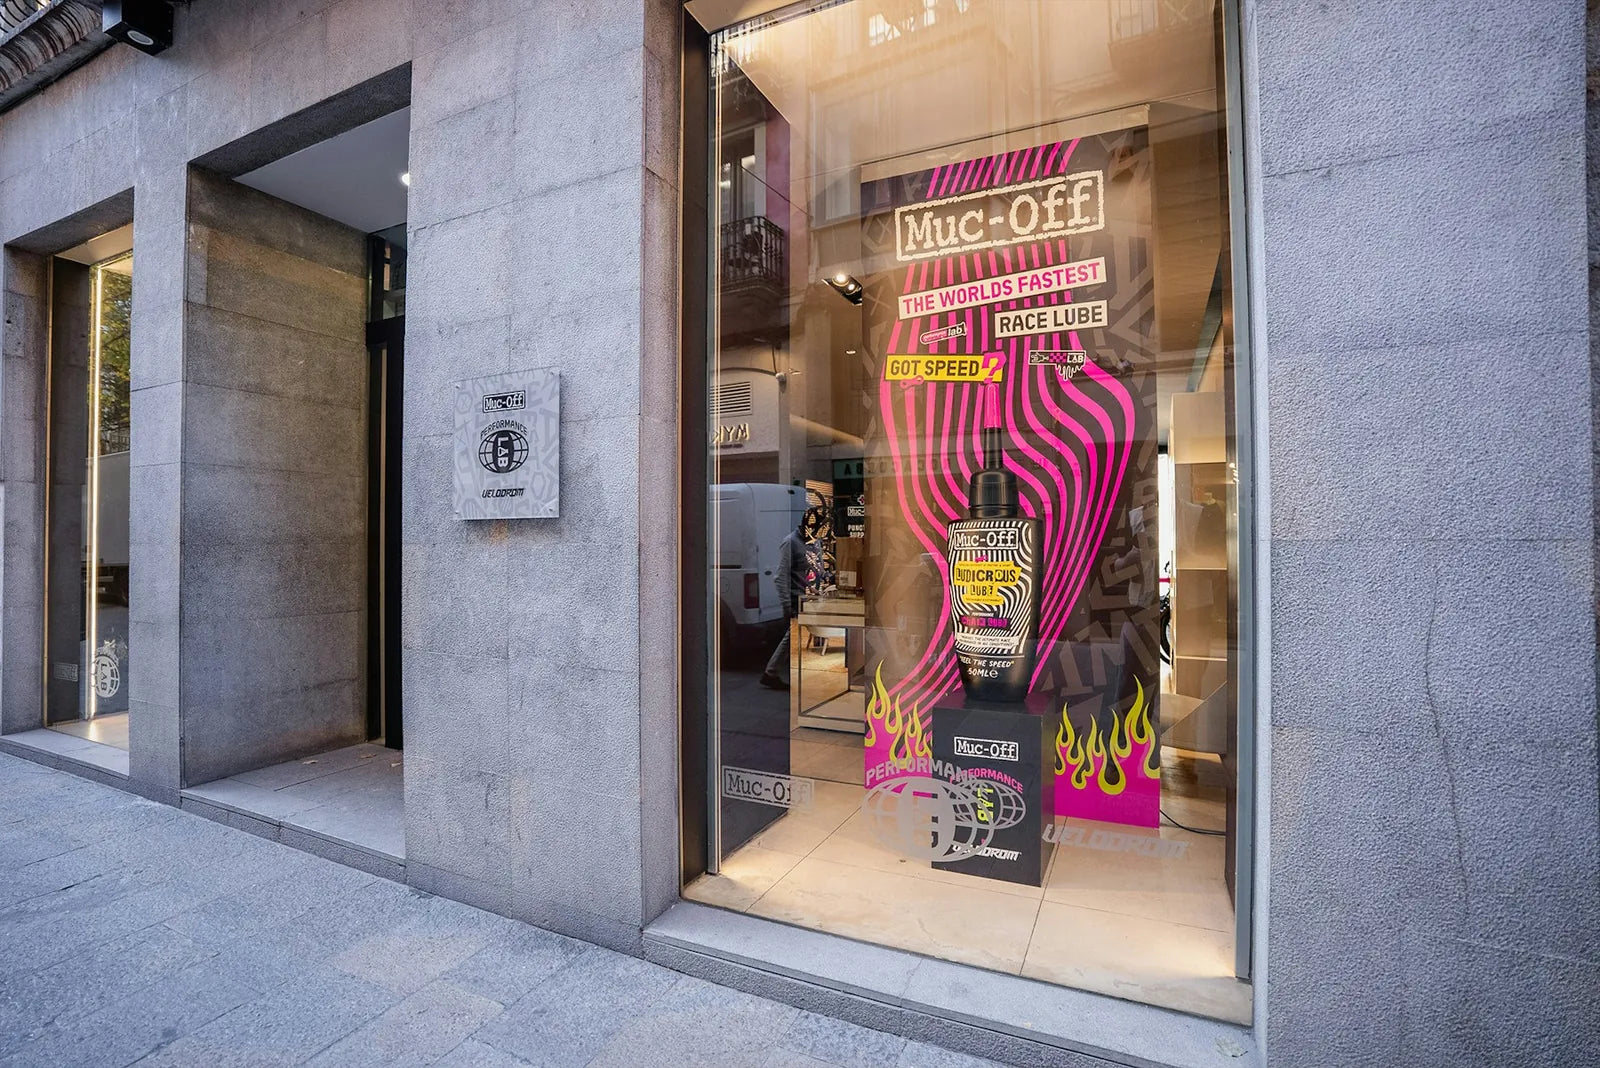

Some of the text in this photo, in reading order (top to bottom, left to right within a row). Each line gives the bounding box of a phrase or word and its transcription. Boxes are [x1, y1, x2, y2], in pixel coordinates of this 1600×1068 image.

[904, 178, 1097, 251] Muc-Off
[903, 261, 1101, 315] THE WORLDS FASTEST
[999, 304, 1103, 333] RACE LUBE
[890, 359, 920, 376] GOT
[484, 393, 523, 410] Muc-Off
[480, 419, 528, 440] PERFORMANCE
[497, 436, 509, 468] LAB
[956, 532, 1017, 548] Muc-Off
[956, 568, 1016, 583] LUDICROUS
[973, 659, 987, 667] THE
[956, 739, 1016, 759] Muc-Off
